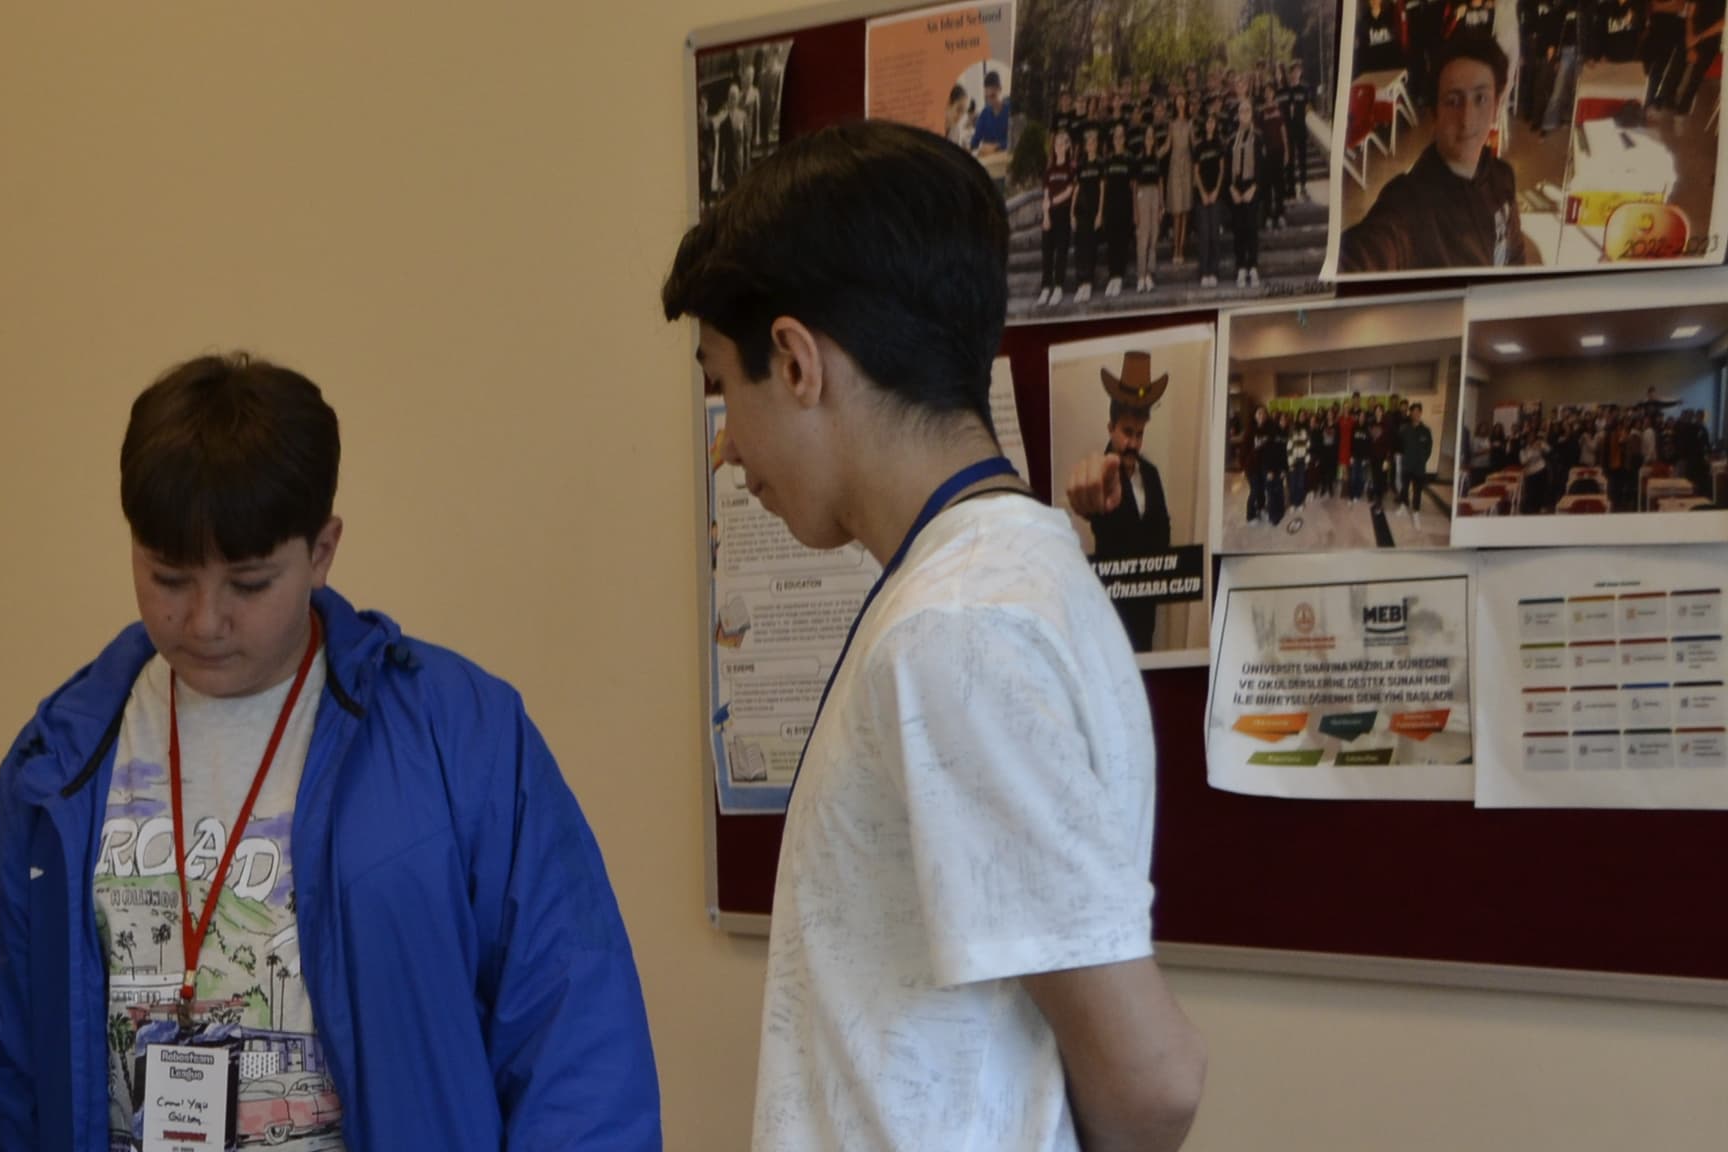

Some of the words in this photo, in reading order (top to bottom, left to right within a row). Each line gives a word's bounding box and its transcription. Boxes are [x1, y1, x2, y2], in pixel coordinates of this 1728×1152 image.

[940, 15, 964, 32] Ideal
[966, 8, 1002, 25] School
[945, 37, 980, 53] System
[1098, 559, 1138, 576] WANT
[1138, 555, 1164, 572] YOU
[1164, 553, 1178, 570] IN
[783, 578, 823, 591] EDUCATION
[1169, 577, 1201, 593] CLUB
[1239, 680, 1254, 690] VE
[1347, 676, 1386, 688] DESTEK
[94, 816, 281, 904] ROAD
